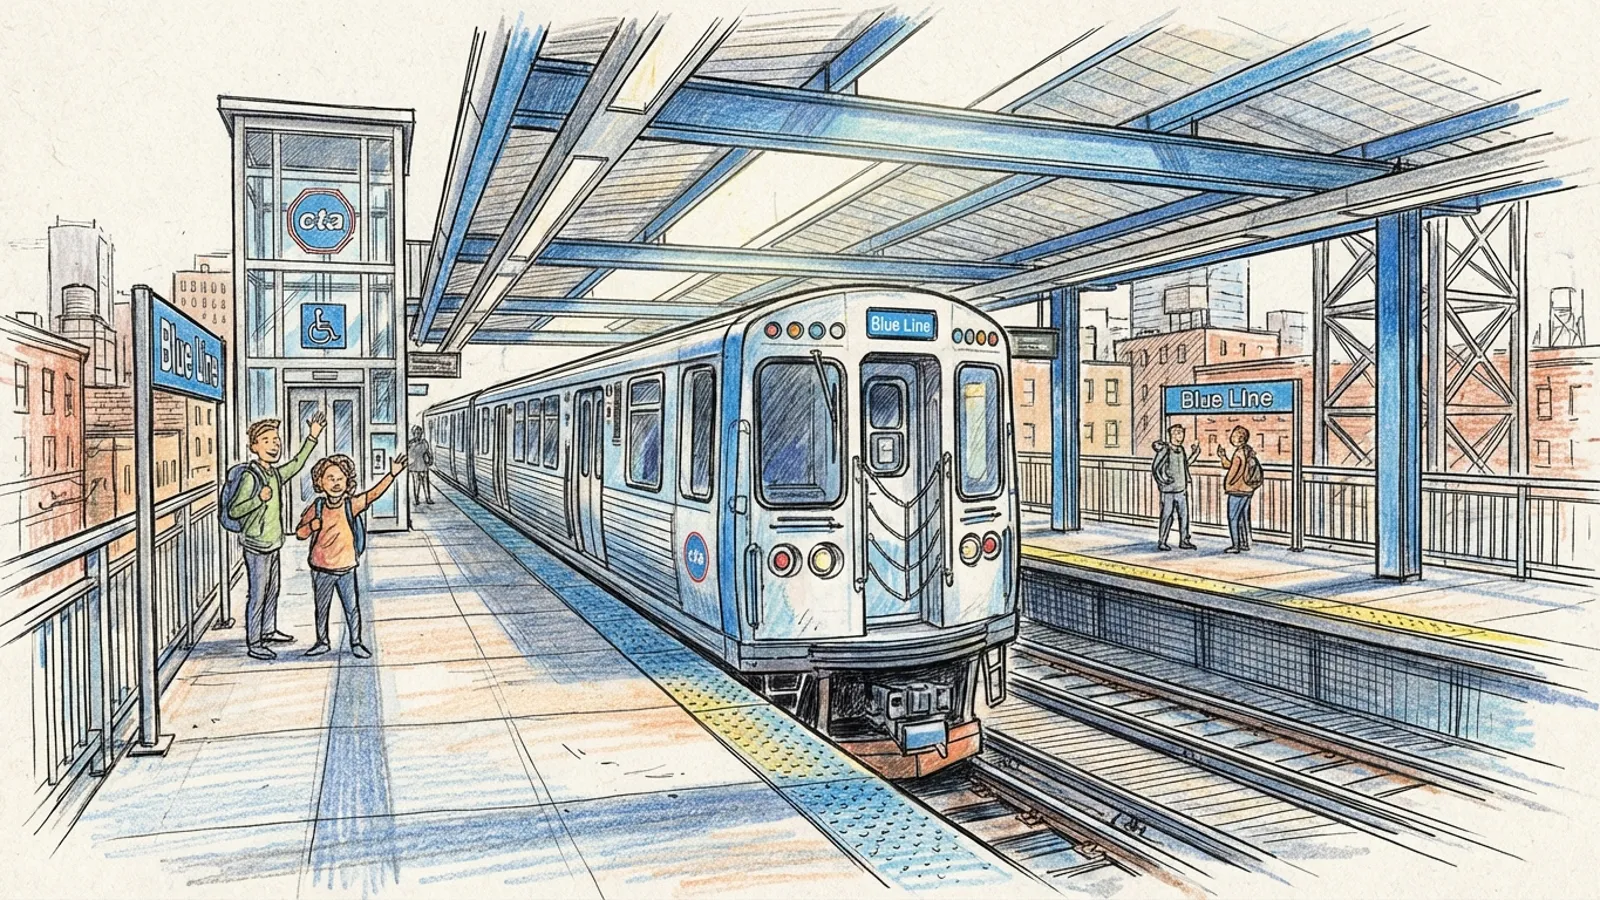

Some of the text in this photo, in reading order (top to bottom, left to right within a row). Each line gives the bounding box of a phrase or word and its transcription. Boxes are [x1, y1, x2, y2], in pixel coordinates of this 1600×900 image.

[299, 208, 345, 231] cta
[871, 315, 931, 333] Blue Line
[160, 317, 219, 388] Blue Line
[1181, 389, 1223, 409] Blue
